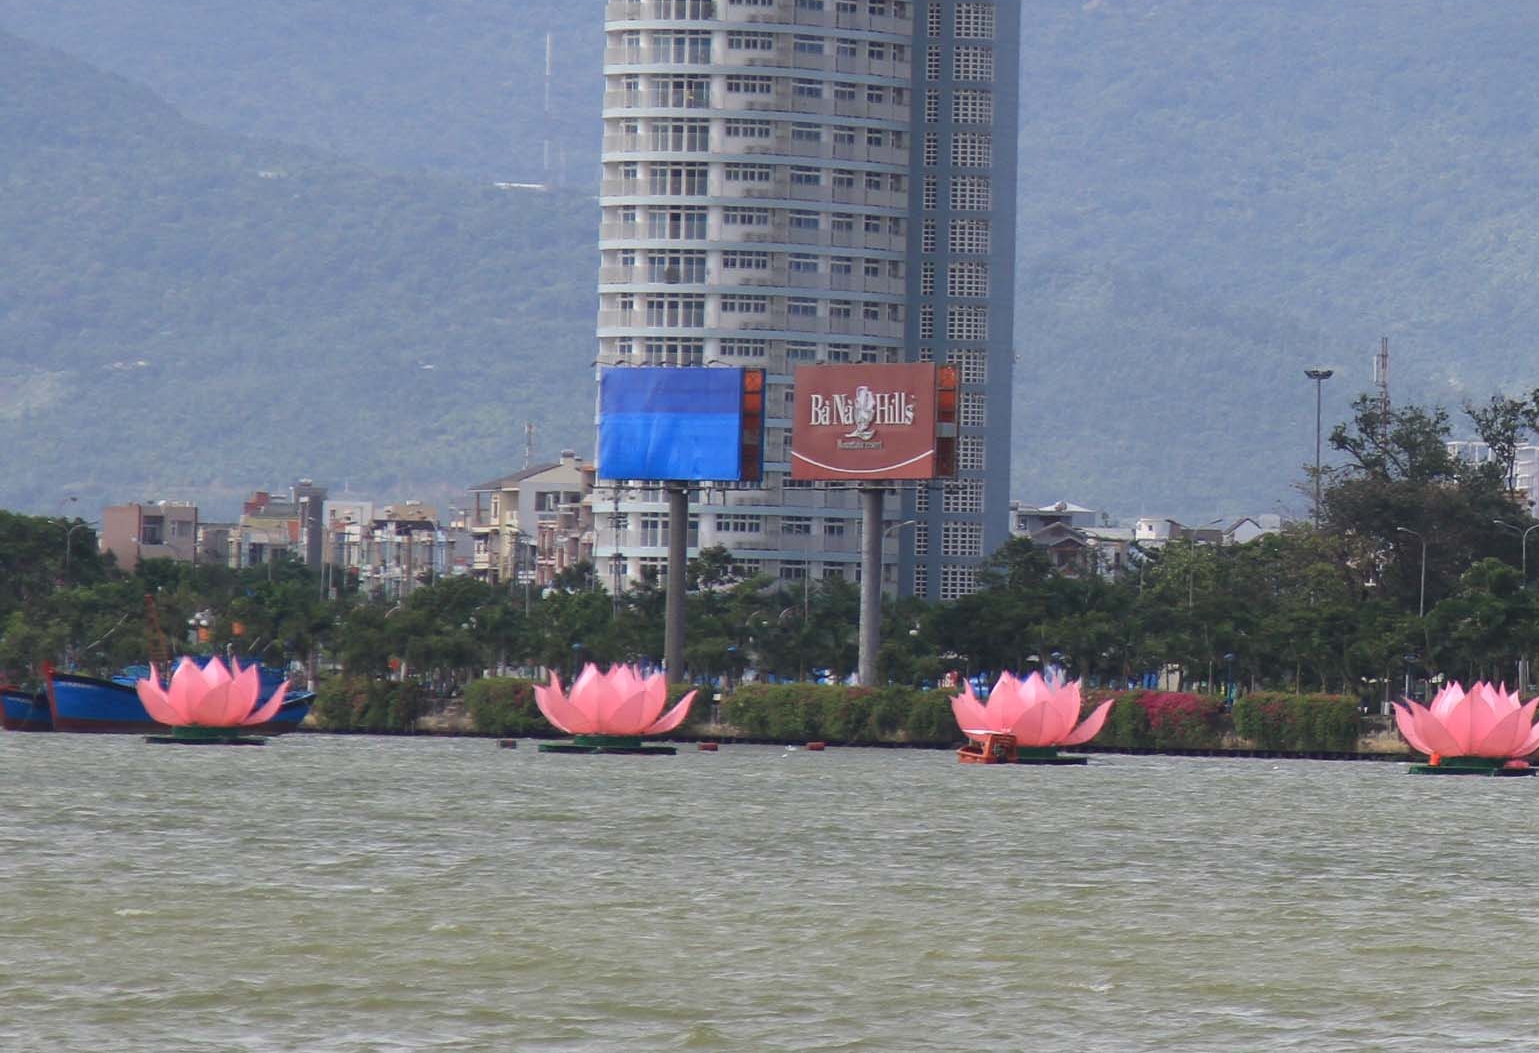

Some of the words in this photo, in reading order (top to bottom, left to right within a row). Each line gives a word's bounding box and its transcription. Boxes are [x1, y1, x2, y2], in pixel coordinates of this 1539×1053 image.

[809, 394, 831, 426] Bà
[832, 393, 855, 426] Nà
[875, 392, 914, 425] Hills
